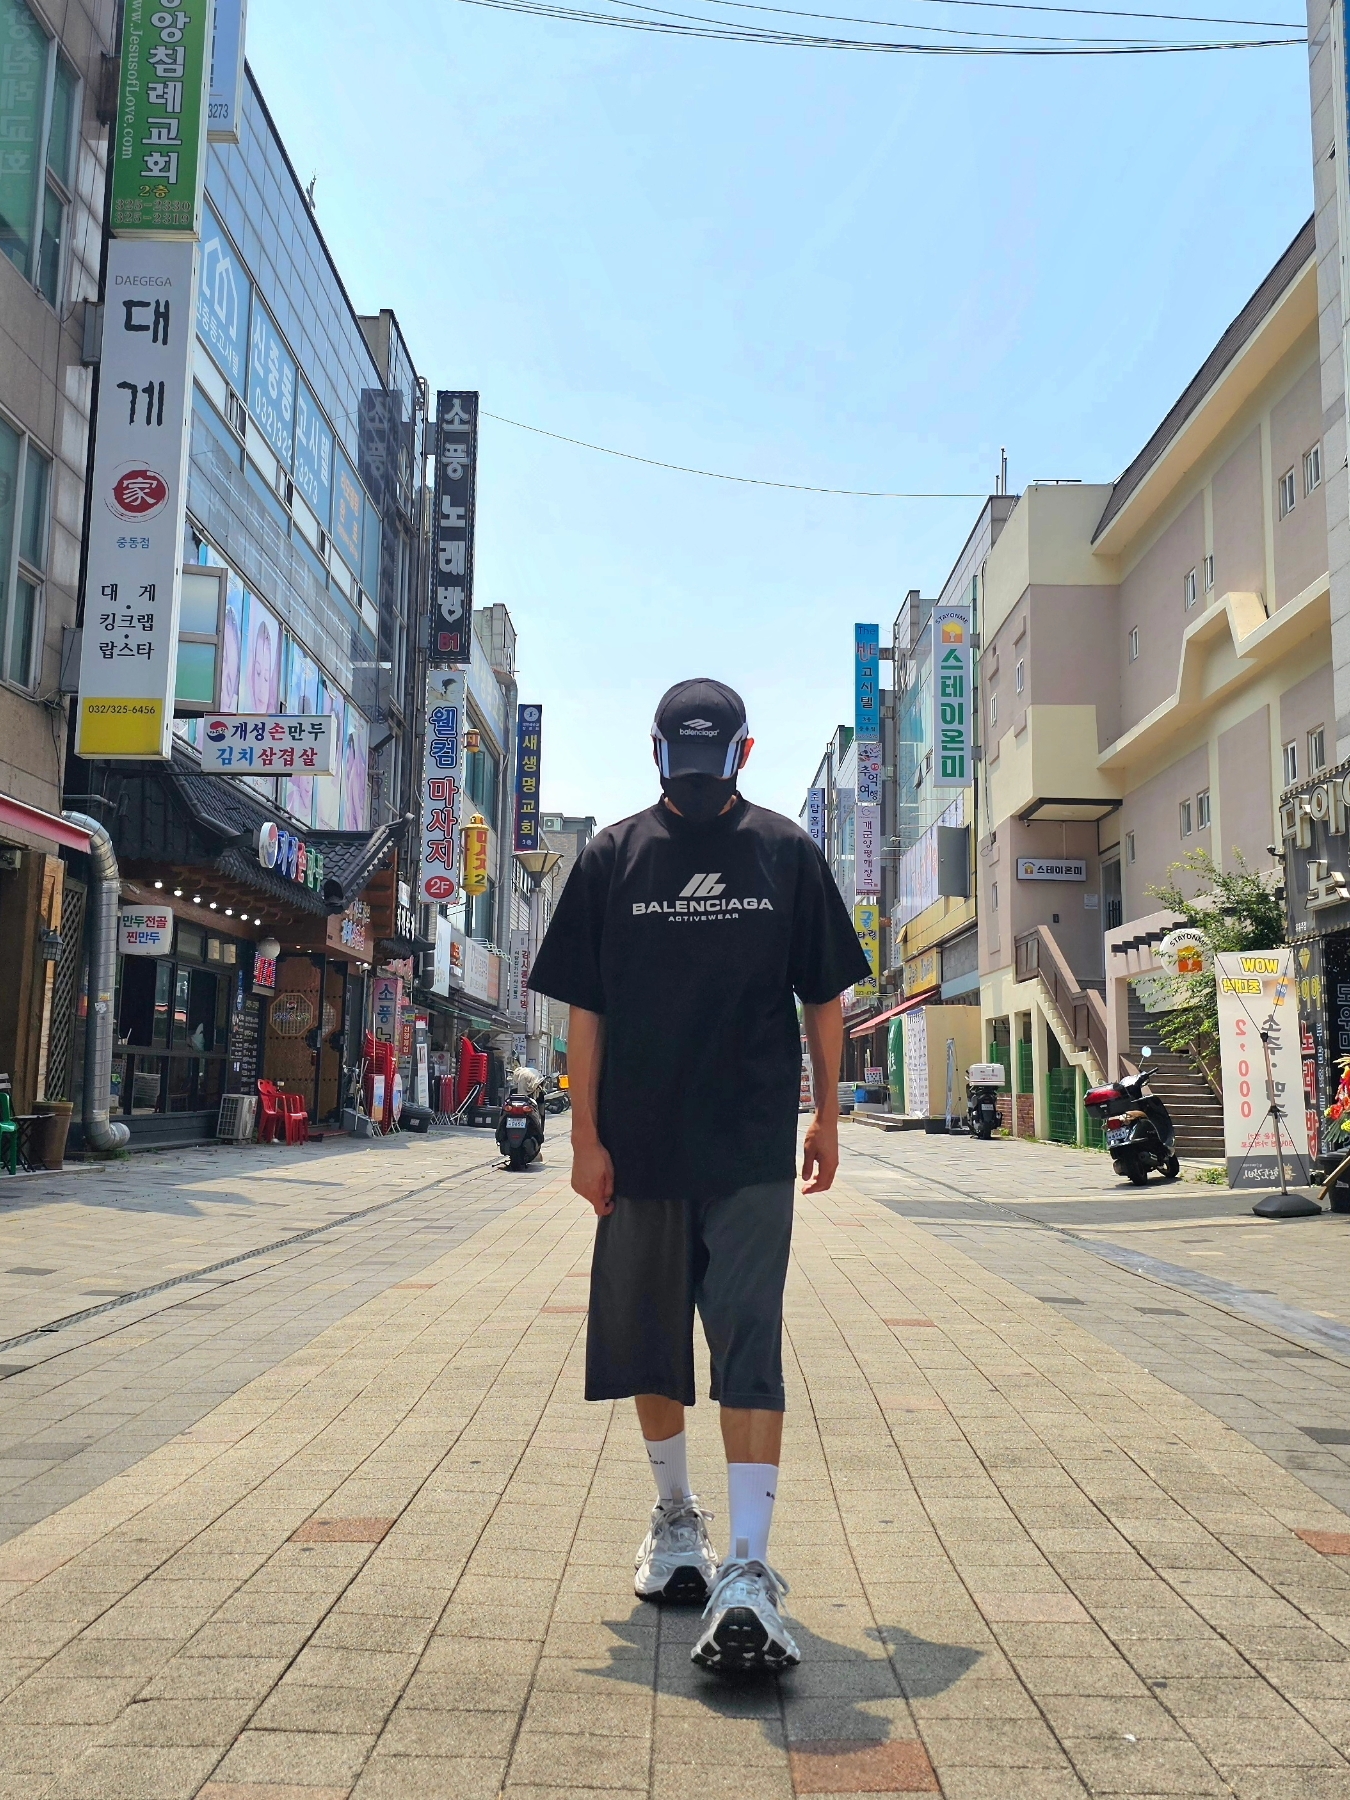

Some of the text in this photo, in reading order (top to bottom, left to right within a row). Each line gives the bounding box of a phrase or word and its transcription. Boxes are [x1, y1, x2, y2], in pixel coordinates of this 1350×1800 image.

[138, 185, 169, 198] 2층
[115, 200, 191, 212] 325-2330
[114, 212, 190, 225] 325-2319
[115, 275, 172, 287] DAEGEGA
[122, 477, 157, 505] 家
[116, 536, 150, 549] 중동점
[99, 613, 154, 631] 킹크랩
[858, 626, 876, 635] The
[438, 631, 460, 651] B1
[99, 642, 154, 661] 랍스타
[861, 667, 873, 709] 고시텔
[88, 705, 156, 715] 032/325-6456
[940, 648, 964, 778] 스테이온미
[231, 721, 325, 741] 개성손만두
[429, 706, 458, 768] 웰컴
[679, 727, 719, 737] balenciaga
[216, 746, 318, 767] 김치삼겹살
[520, 735, 538, 836] 새생명교회
[426, 776, 459, 870] 마사지
[1037, 865, 1082, 875] 스테이온미
[430, 879, 450, 893] 2F
[632, 898, 774, 916] BALENCIAGA
[122, 915, 168, 929] 만두전골
[668, 913, 739, 922] ACTIVEWEAR
[126, 931, 161, 944] 찐만두
[1300, 1020, 1319, 1161] 노래방
